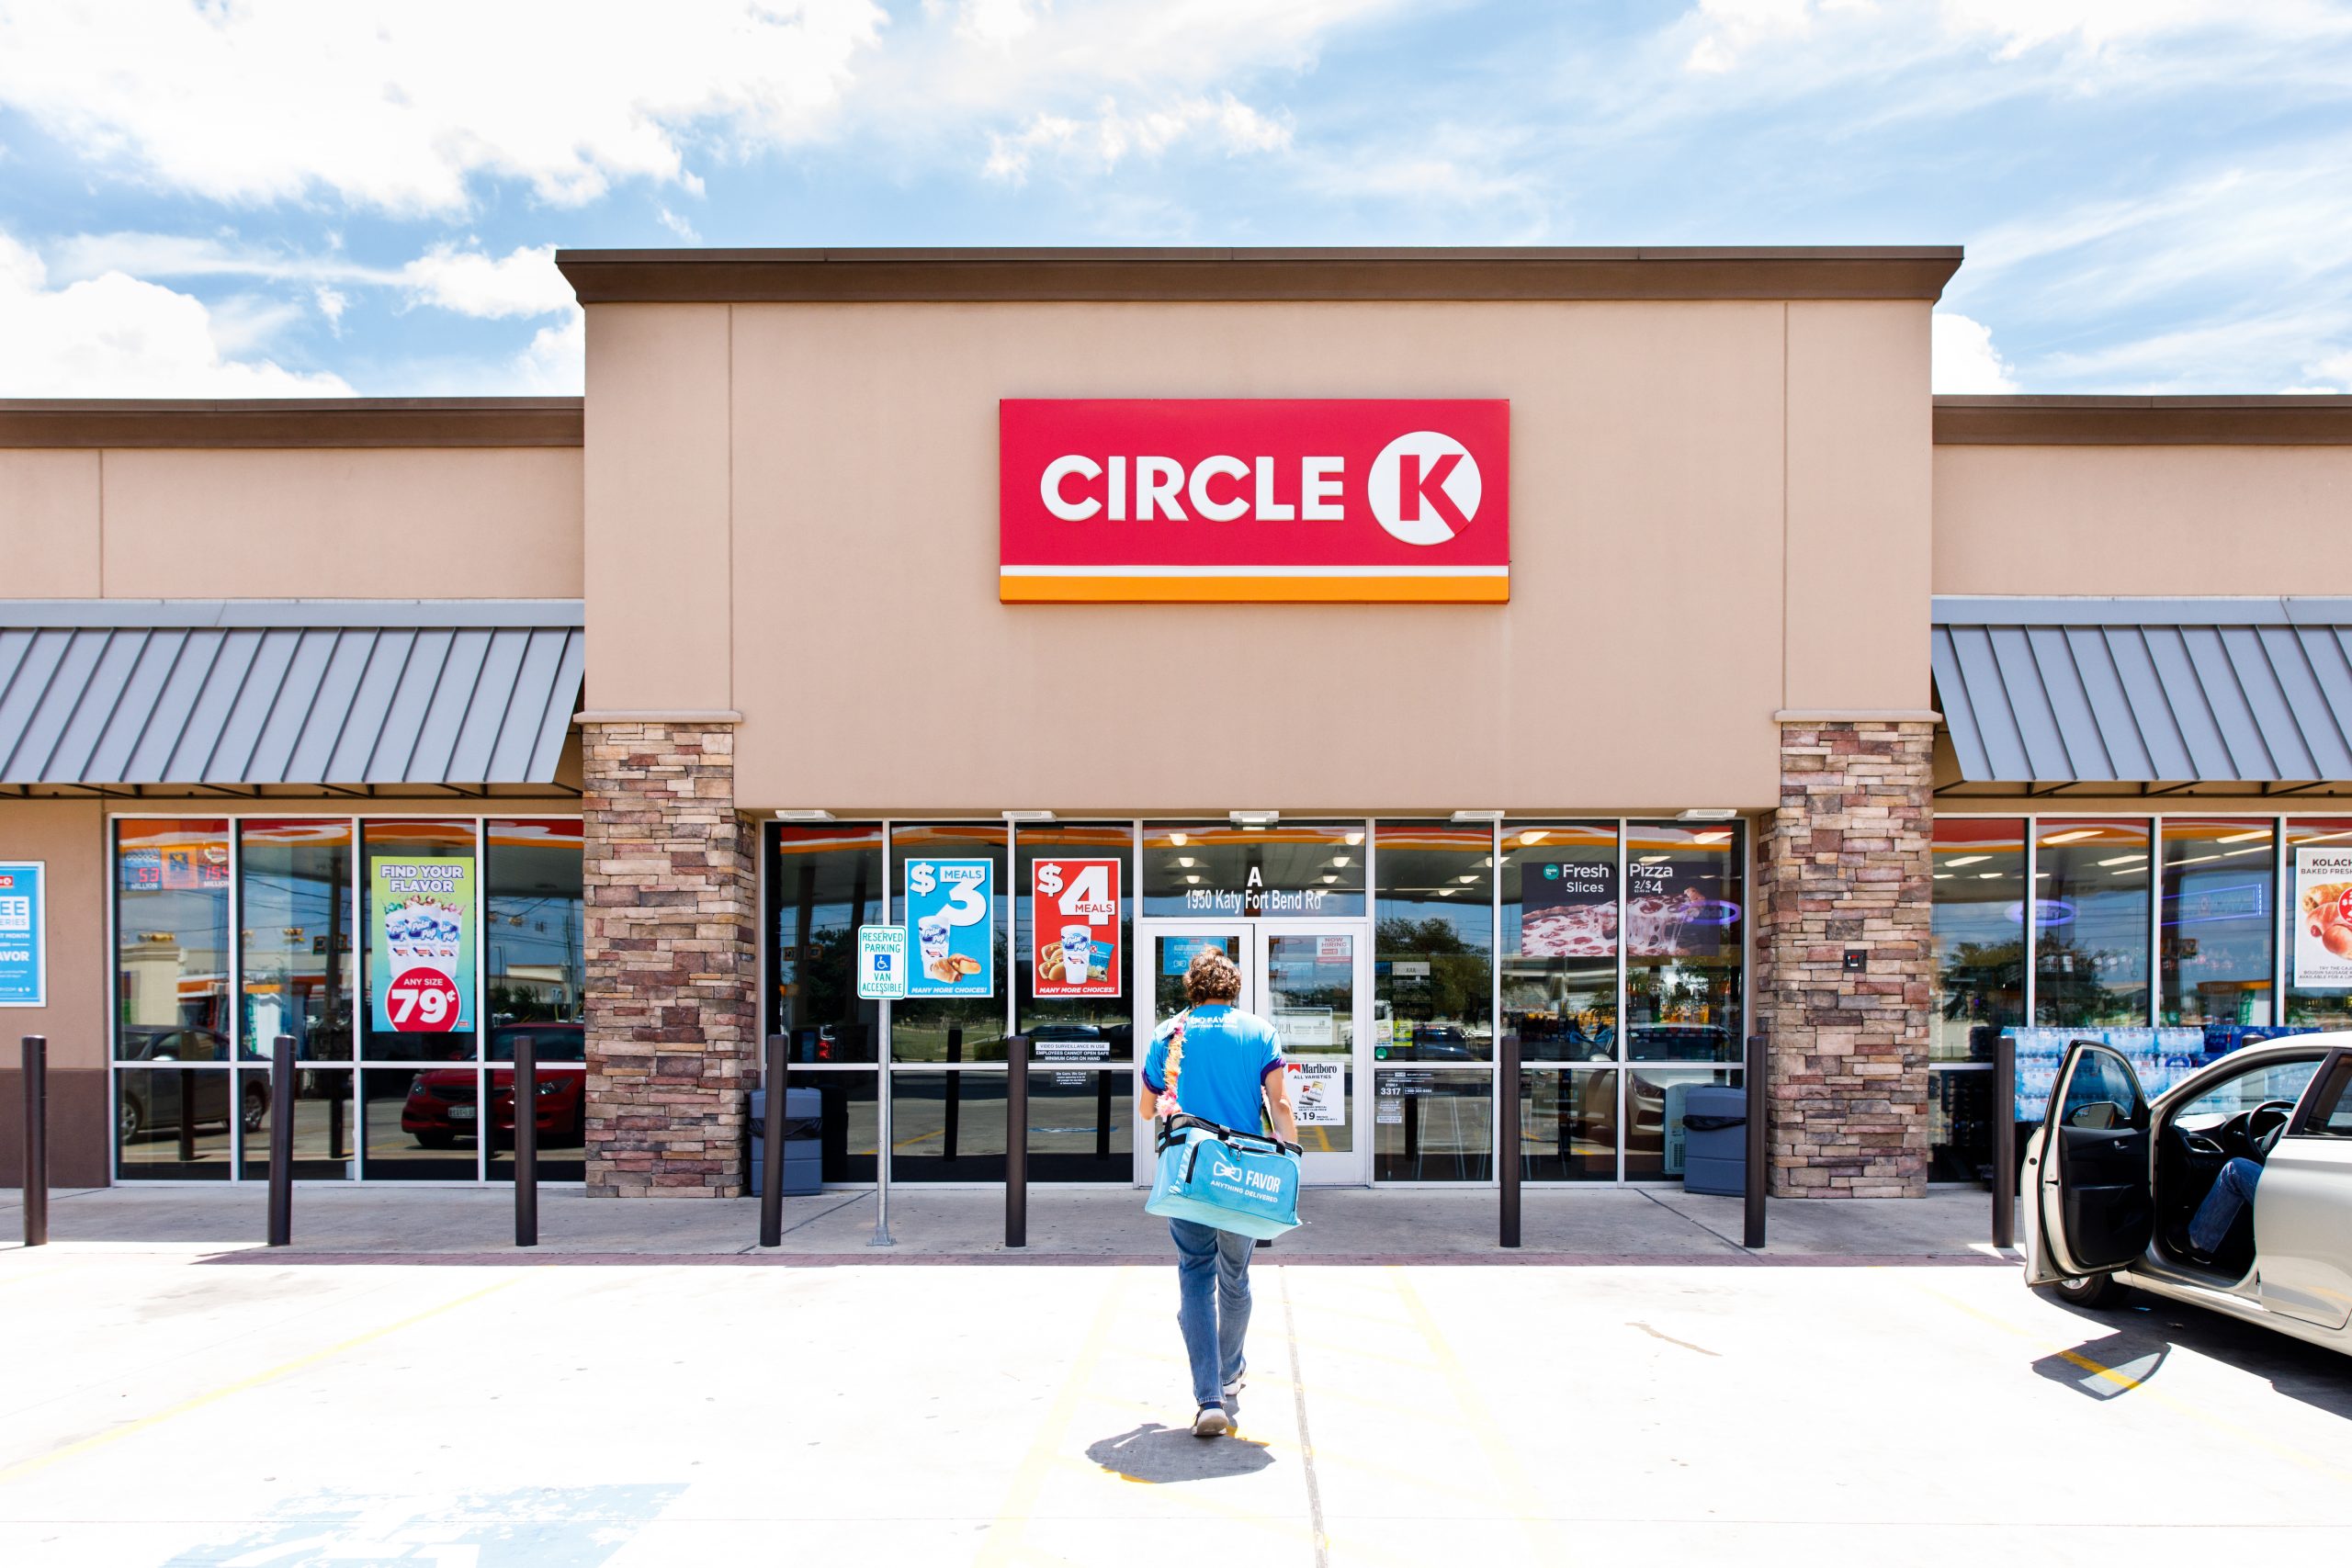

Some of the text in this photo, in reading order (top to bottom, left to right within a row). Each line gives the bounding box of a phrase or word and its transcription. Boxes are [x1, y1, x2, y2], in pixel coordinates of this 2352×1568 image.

[1040, 453, 1470, 536] CIRCLE K
[139, 867, 160, 883] 53
[380, 864, 464, 878] FIND YOUR
[944, 870, 982, 879] MEALS
[1247, 866, 1263, 887] A
[1563, 863, 1673, 878] Fresh Pizza
[390, 879, 455, 893] FLAVOR
[1566, 882, 1604, 893] Slices
[1075, 904, 1113, 913] MEALS
[1186, 889, 1212, 909] 1950
[1216, 889, 1241, 914] Katy
[1245, 889, 1269, 909] Fort
[1272, 889, 1302, 909] Bend
[862, 932, 903, 942] RESERVED
[865, 943, 900, 953] PARKING
[874, 973, 891, 982] VAN
[862, 983, 902, 993] ACCESSIBLE
[1301, 1064, 1338, 1074] Marlboro
[1246, 1169, 1282, 1193] FAVOR
[1210, 1179, 1279, 1203] ANYTHING DELIVERED
